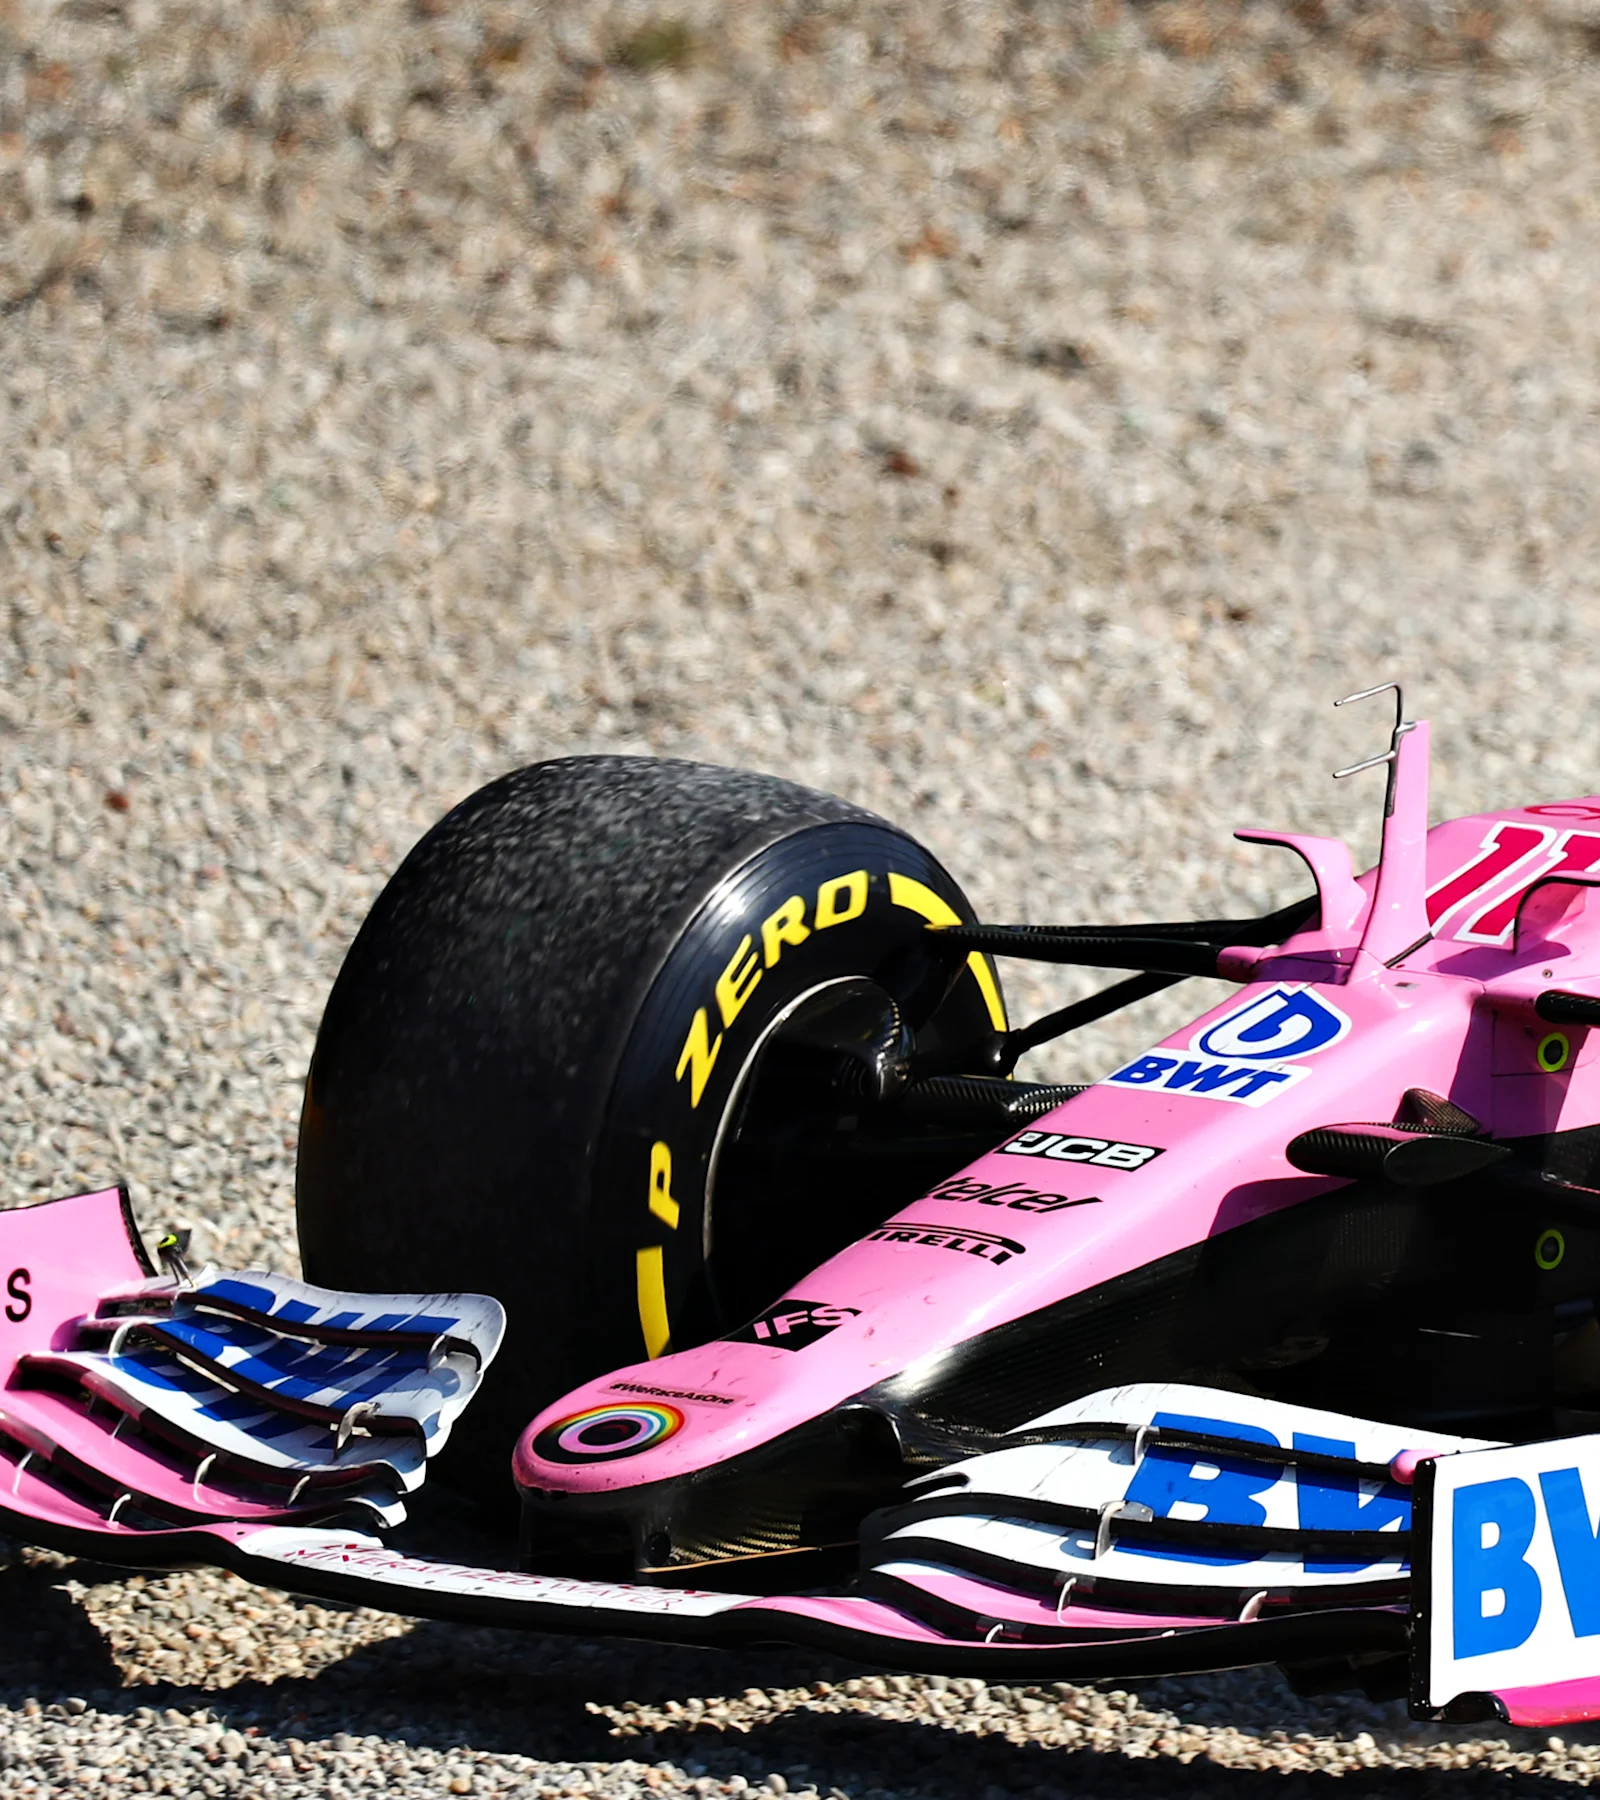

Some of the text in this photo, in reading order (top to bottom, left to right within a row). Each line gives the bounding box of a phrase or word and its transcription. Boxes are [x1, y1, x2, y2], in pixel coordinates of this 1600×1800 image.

[648, 869, 869, 1230] P ZERO
[1108, 1055, 1292, 1099] BWT
[1004, 1131, 1156, 1169] JCB
[926, 1177, 1104, 1214] telcel
[752, 1304, 857, 1340] IFS
[609, 1382, 735, 1405] #WeRaceAsOne
[283, 1548, 541, 1587] MINERALIZED
[550, 1580, 686, 1610] WATER
